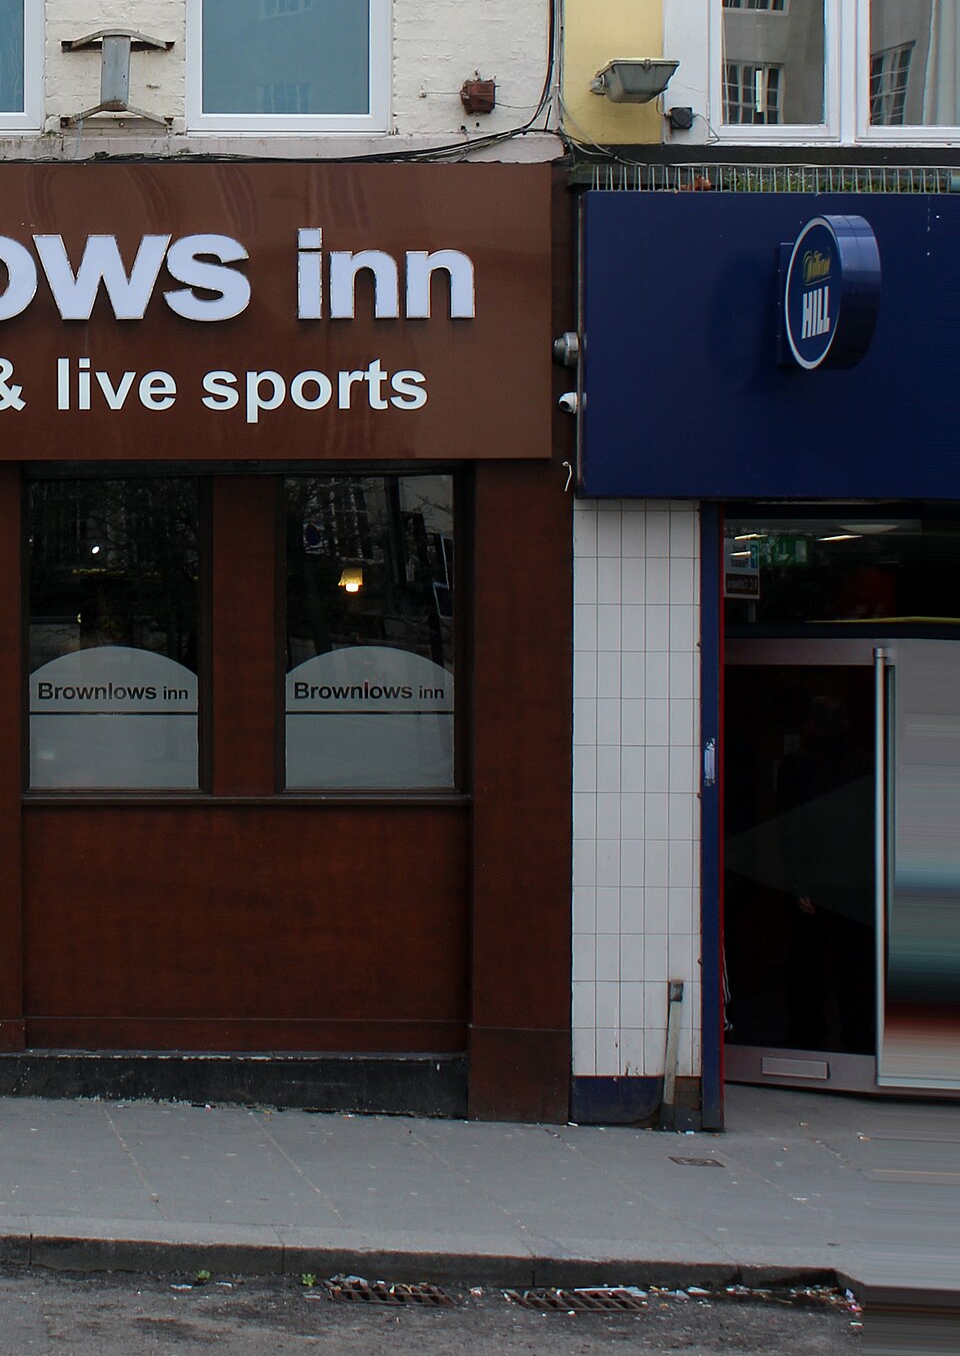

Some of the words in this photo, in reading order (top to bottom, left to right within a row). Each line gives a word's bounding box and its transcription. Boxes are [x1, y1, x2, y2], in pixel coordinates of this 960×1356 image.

[296, 227, 477, 321] inn
[801, 285, 831, 339] HILL
[56, 357, 178, 412] live
[200, 357, 430, 424] sports
[38, 682, 157, 701] Brownlows
[163, 685, 189, 701] inn
[294, 681, 413, 700] Brownlows
[419, 685, 445, 700] inn
